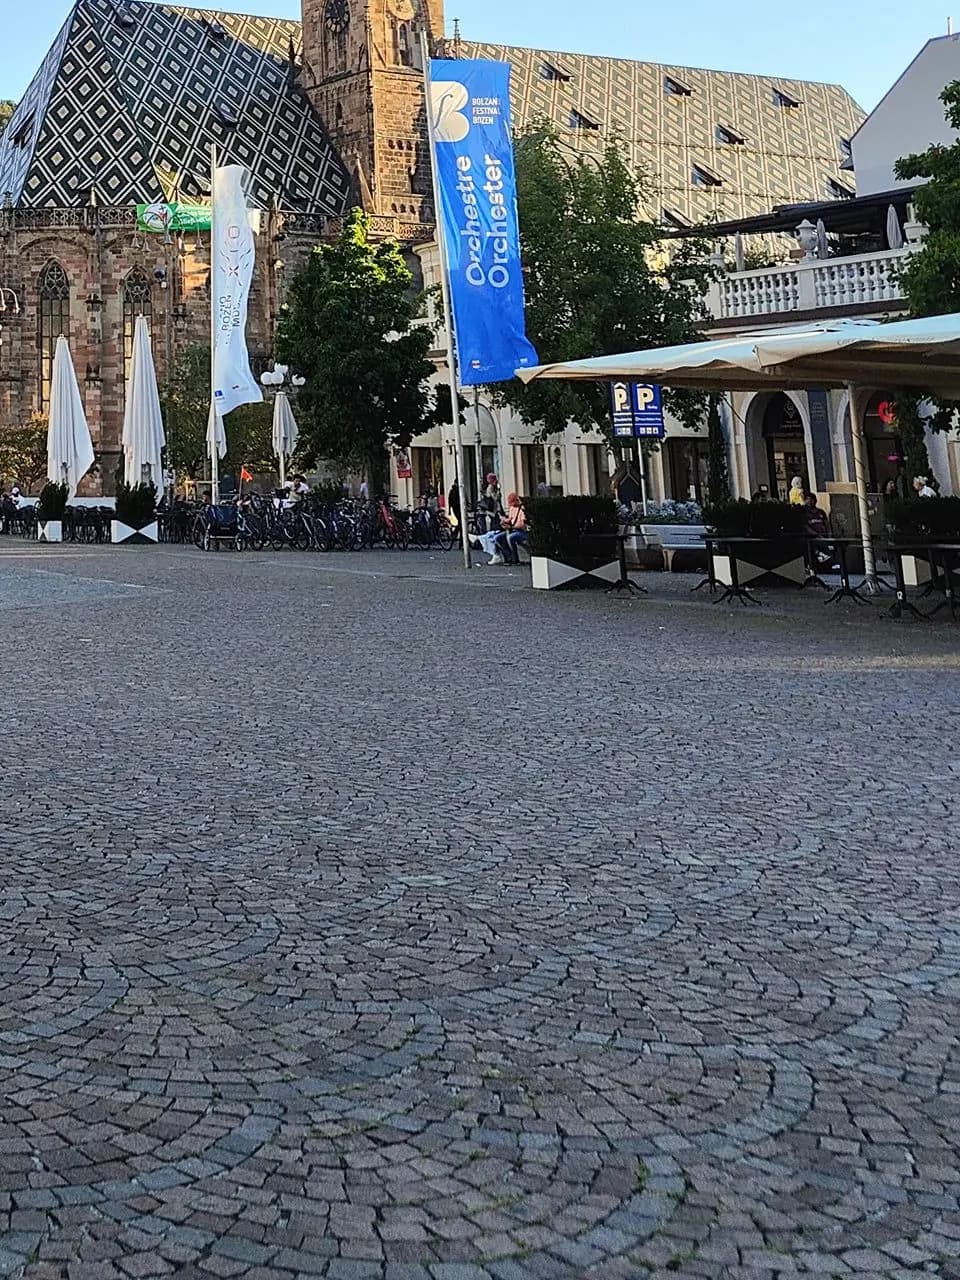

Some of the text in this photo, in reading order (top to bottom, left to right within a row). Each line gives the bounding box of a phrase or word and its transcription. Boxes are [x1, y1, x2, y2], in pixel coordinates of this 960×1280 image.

[472, 106, 501, 115] FESTIVAL
[472, 116, 494, 125] BOZEN
[456, 155, 486, 287] Orchestre
[483, 153, 510, 289] Orchester
[614, 388, 627, 412] P
[636, 387, 654, 411] P
